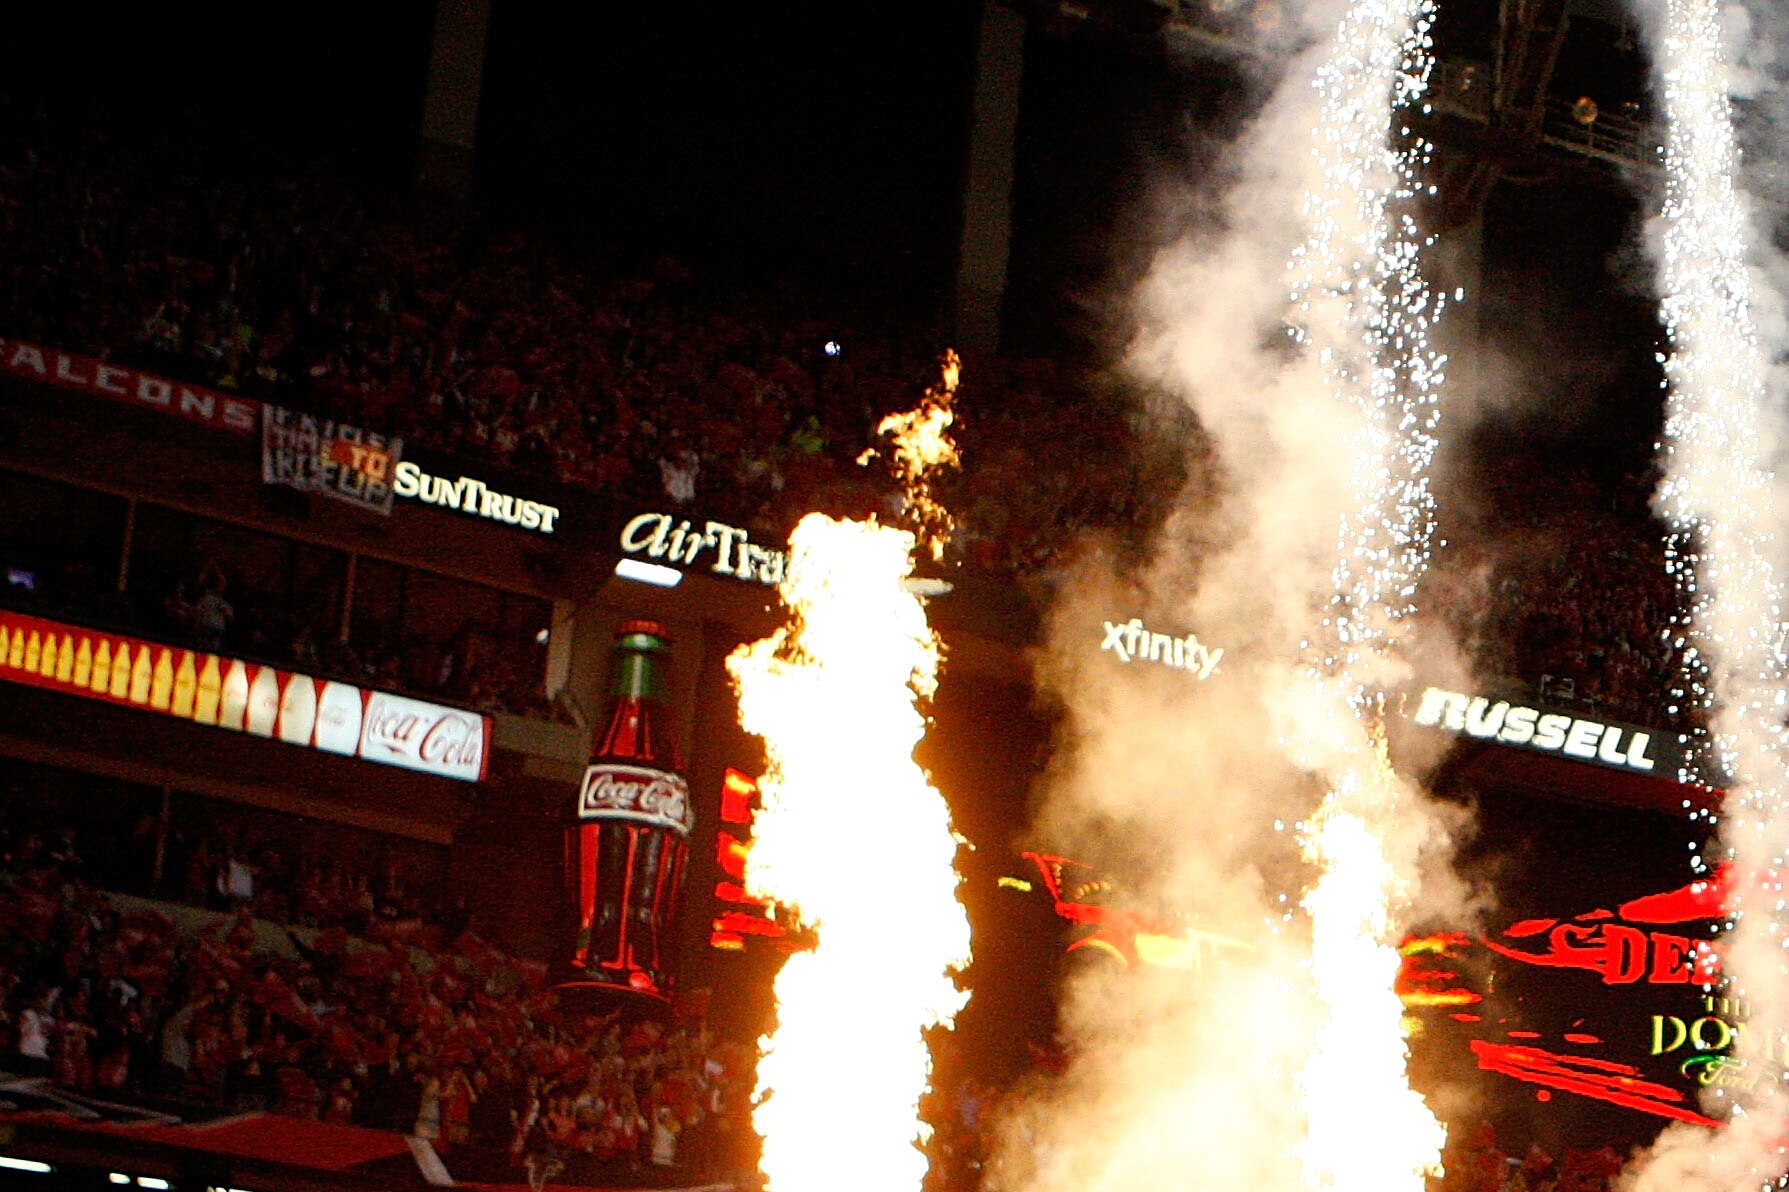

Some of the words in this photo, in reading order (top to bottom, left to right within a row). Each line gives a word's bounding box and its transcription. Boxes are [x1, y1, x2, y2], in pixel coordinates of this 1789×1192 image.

[0, 340, 255, 430] ALCONS
[620, 513, 788, 584] airTra
[1101, 618, 1224, 681] xfinity
[1415, 687, 1654, 770] RUSSELL
